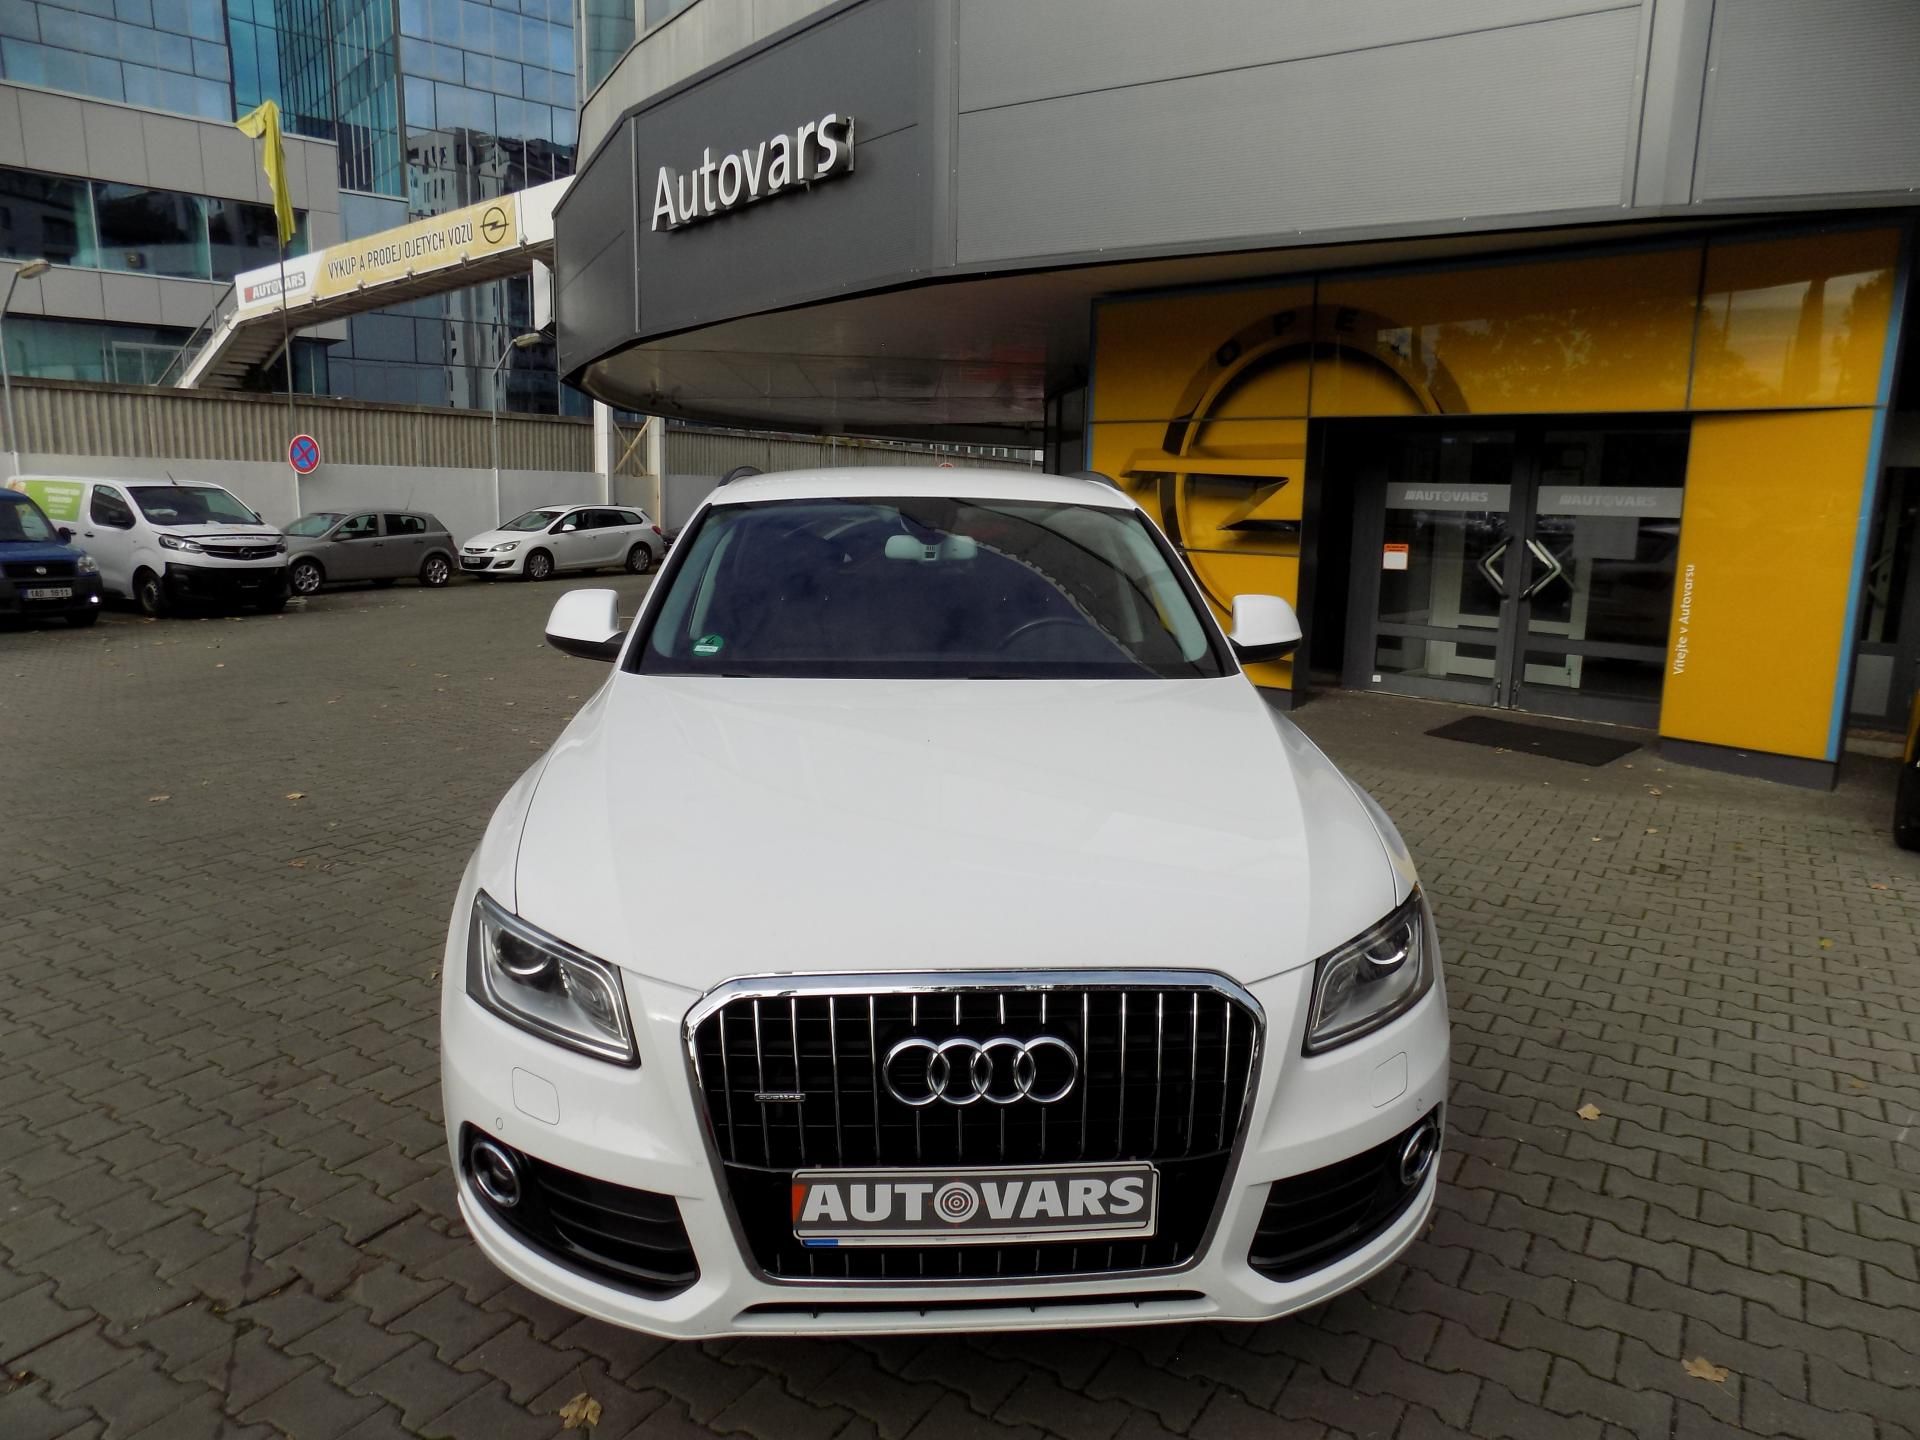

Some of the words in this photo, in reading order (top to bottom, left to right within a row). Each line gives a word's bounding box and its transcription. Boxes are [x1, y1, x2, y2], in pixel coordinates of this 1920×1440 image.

[652, 113, 837, 231] Autovars
[328, 255, 357, 279] VÝKUP
[359, 254, 366, 271] A
[367, 245, 402, 269] PRODEJ
[404, 230, 446, 259] OJETÝCH
[1412, 490, 1489, 503] AUTOVARS
[1568, 494, 1657, 508] AUTOVARS
[1679, 564, 1696, 625] Autovarsu
[1680, 626, 1689, 634] v
[801, 1177, 1145, 1222] AUTOVARS
